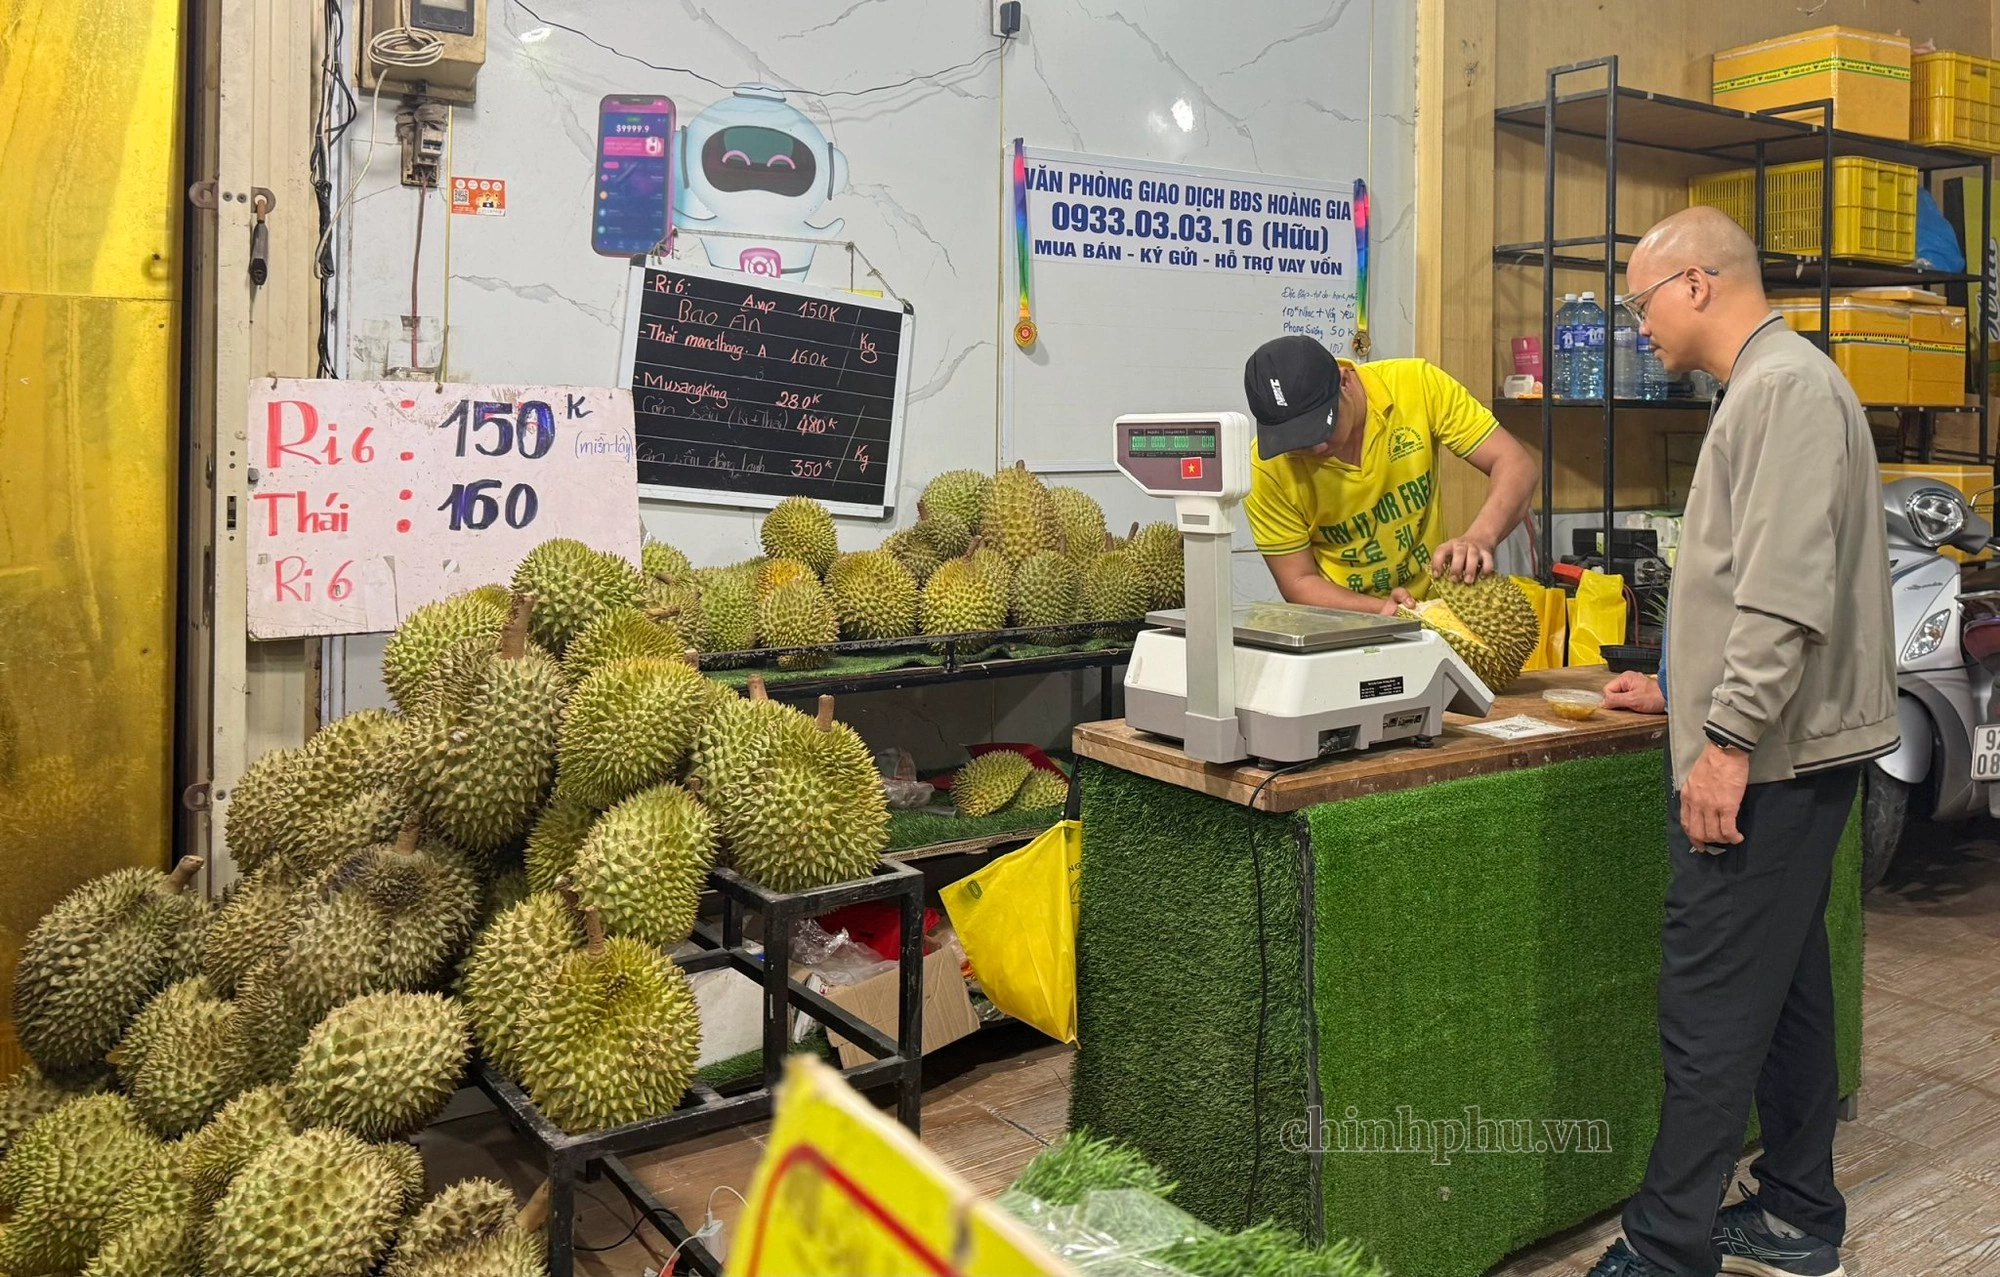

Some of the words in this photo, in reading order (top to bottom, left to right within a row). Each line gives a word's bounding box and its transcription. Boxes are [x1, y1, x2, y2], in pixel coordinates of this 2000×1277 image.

[1024, 164, 1063, 193] VĂN
[1069, 171, 1133, 200] PHÒNG
[1138, 181, 1179, 206] GIAO
[1185, 185, 1225, 212] DỊCH
[1230, 190, 1263, 214] BĐS
[1267, 192, 1321, 218] HOÀNG
[1326, 199, 1352, 221] GIA
[1051, 201, 1252, 246] 0933.03.03.16
[1262, 221, 1329, 255] (Hữu)
[1034, 239, 1077, 257] MUA
[1083, 242, 1122, 261] BÁN
[1140, 246, 1163, 264] KÝ
[1168, 246, 1198, 266] GỬI
[1215, 249, 1237, 269] HỖ
[1242, 255, 1274, 274] TRỢ
[1278, 258, 1306, 273] VAY
[1310, 256, 1343, 275] VỐN
[266, 399, 342, 469] Ri
[351, 426, 375, 464] 6
[253, 490, 349, 537] Thái
[437, 479, 539, 531] 160
[1318, 521, 1354, 545] TRY
[1351, 511, 1372, 539] IT
[274, 554, 312, 602] Ri
[326, 559, 354, 602] 6
